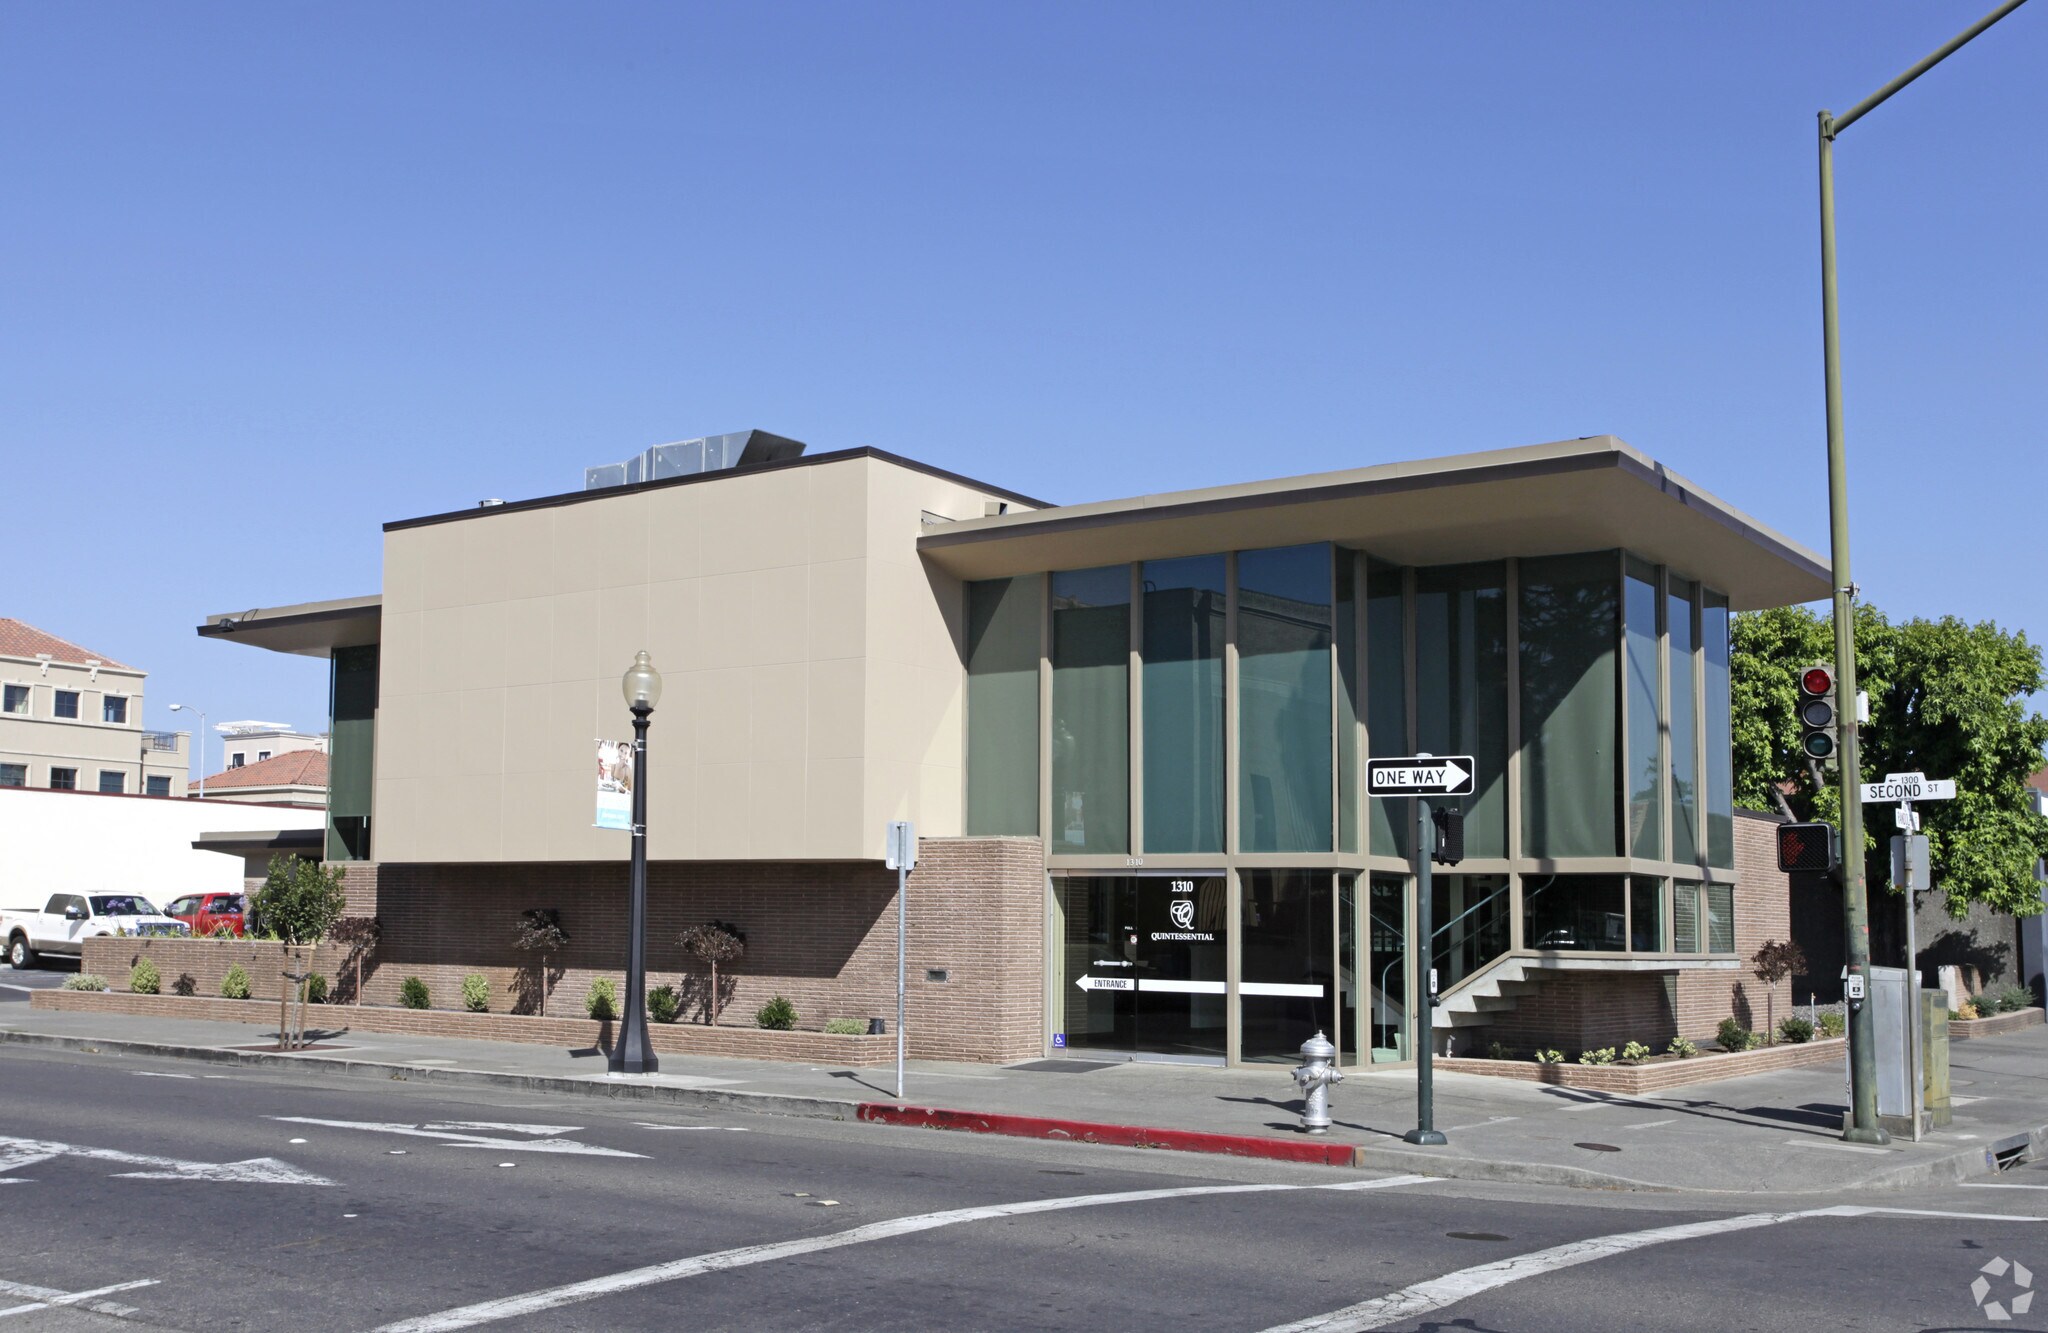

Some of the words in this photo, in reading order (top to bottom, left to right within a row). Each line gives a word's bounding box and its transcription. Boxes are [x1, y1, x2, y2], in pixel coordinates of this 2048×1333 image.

[1376, 770, 1406, 785] ONE
[1413, 769, 1446, 784] WAY
[1901, 776, 1919, 784] 1300
[1870, 784, 1921, 798] SECOND
[1928, 784, 1938, 793] ST
[1126, 858, 1143, 866] 1310
[1171, 881, 1193, 892] 1310
[1151, 932, 1214, 941] QUINTESSENTIAL
[1094, 979, 1127, 988] ENTRANCE
